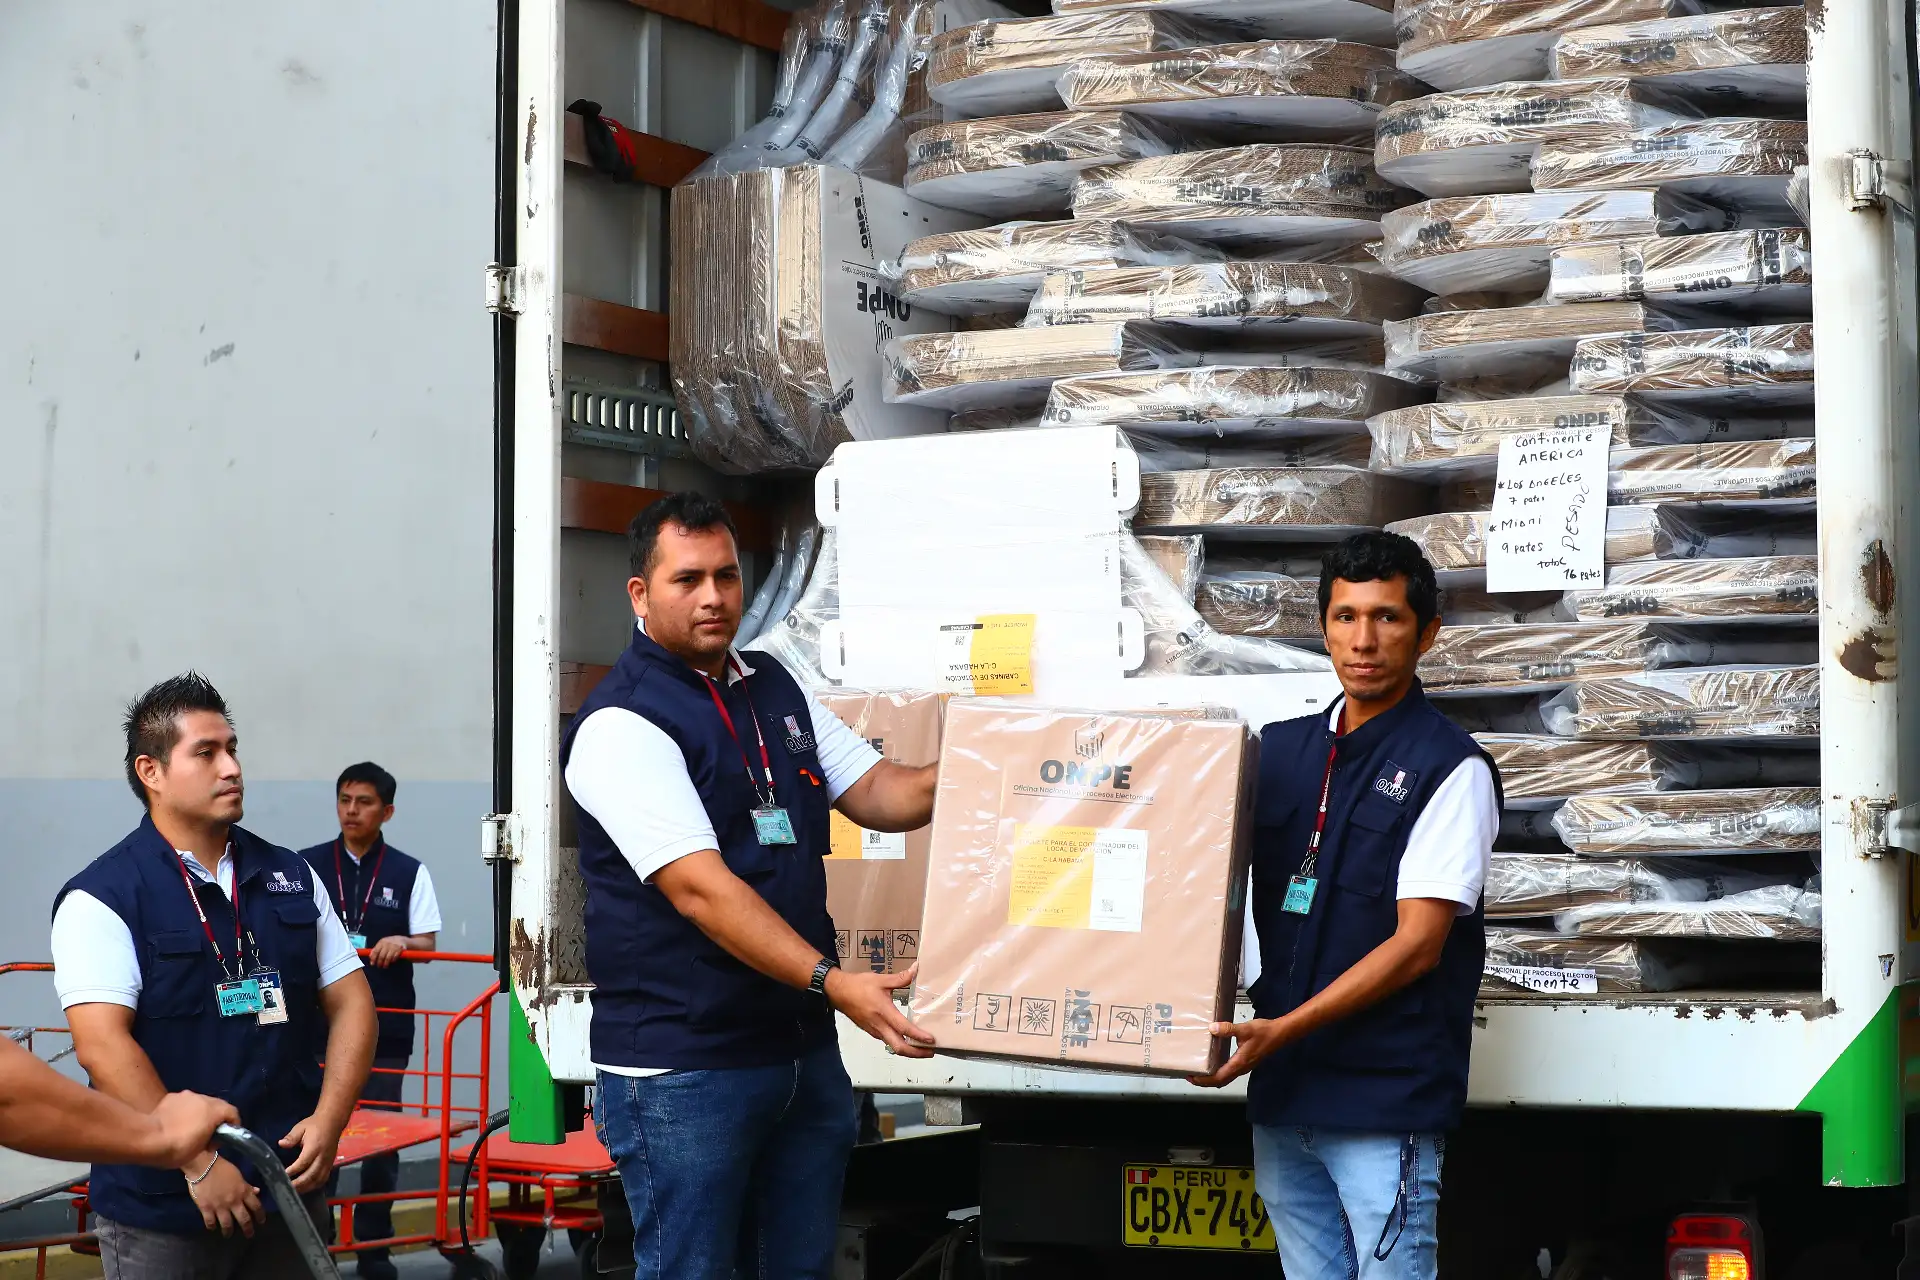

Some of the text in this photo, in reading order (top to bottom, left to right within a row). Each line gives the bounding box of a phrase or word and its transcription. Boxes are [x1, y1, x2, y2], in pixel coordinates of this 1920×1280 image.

[1614, 153, 1646, 163] NACIONAL
[1647, 152, 1655, 161] DE
[855, 196, 870, 249] ONPE
[1673, 275, 1733, 293] ONPE
[856, 281, 911, 322] ONPE
[1656, 483, 1682, 491] OFICINA
[1508, 497, 1518, 505] 7
[1501, 542, 1510, 554] 9
[949, 663, 979, 671] HABANA
[981, 673, 989, 681] DE
[786, 732, 815, 751] ONPE
[1040, 759, 1133, 790] ONPE
[1013, 784, 1039, 793] Oficina
[1375, 778, 1408, 801] ONPE
[1709, 813, 1769, 836] ONPE
[266, 880, 305, 893] ONPE
[1523, 968, 1532, 976] DE
[1532, 970, 1566, 978] PROCESOS
[1173, 1170, 1227, 1187] PERU
[1130, 1186, 1270, 1238] CBX-749
